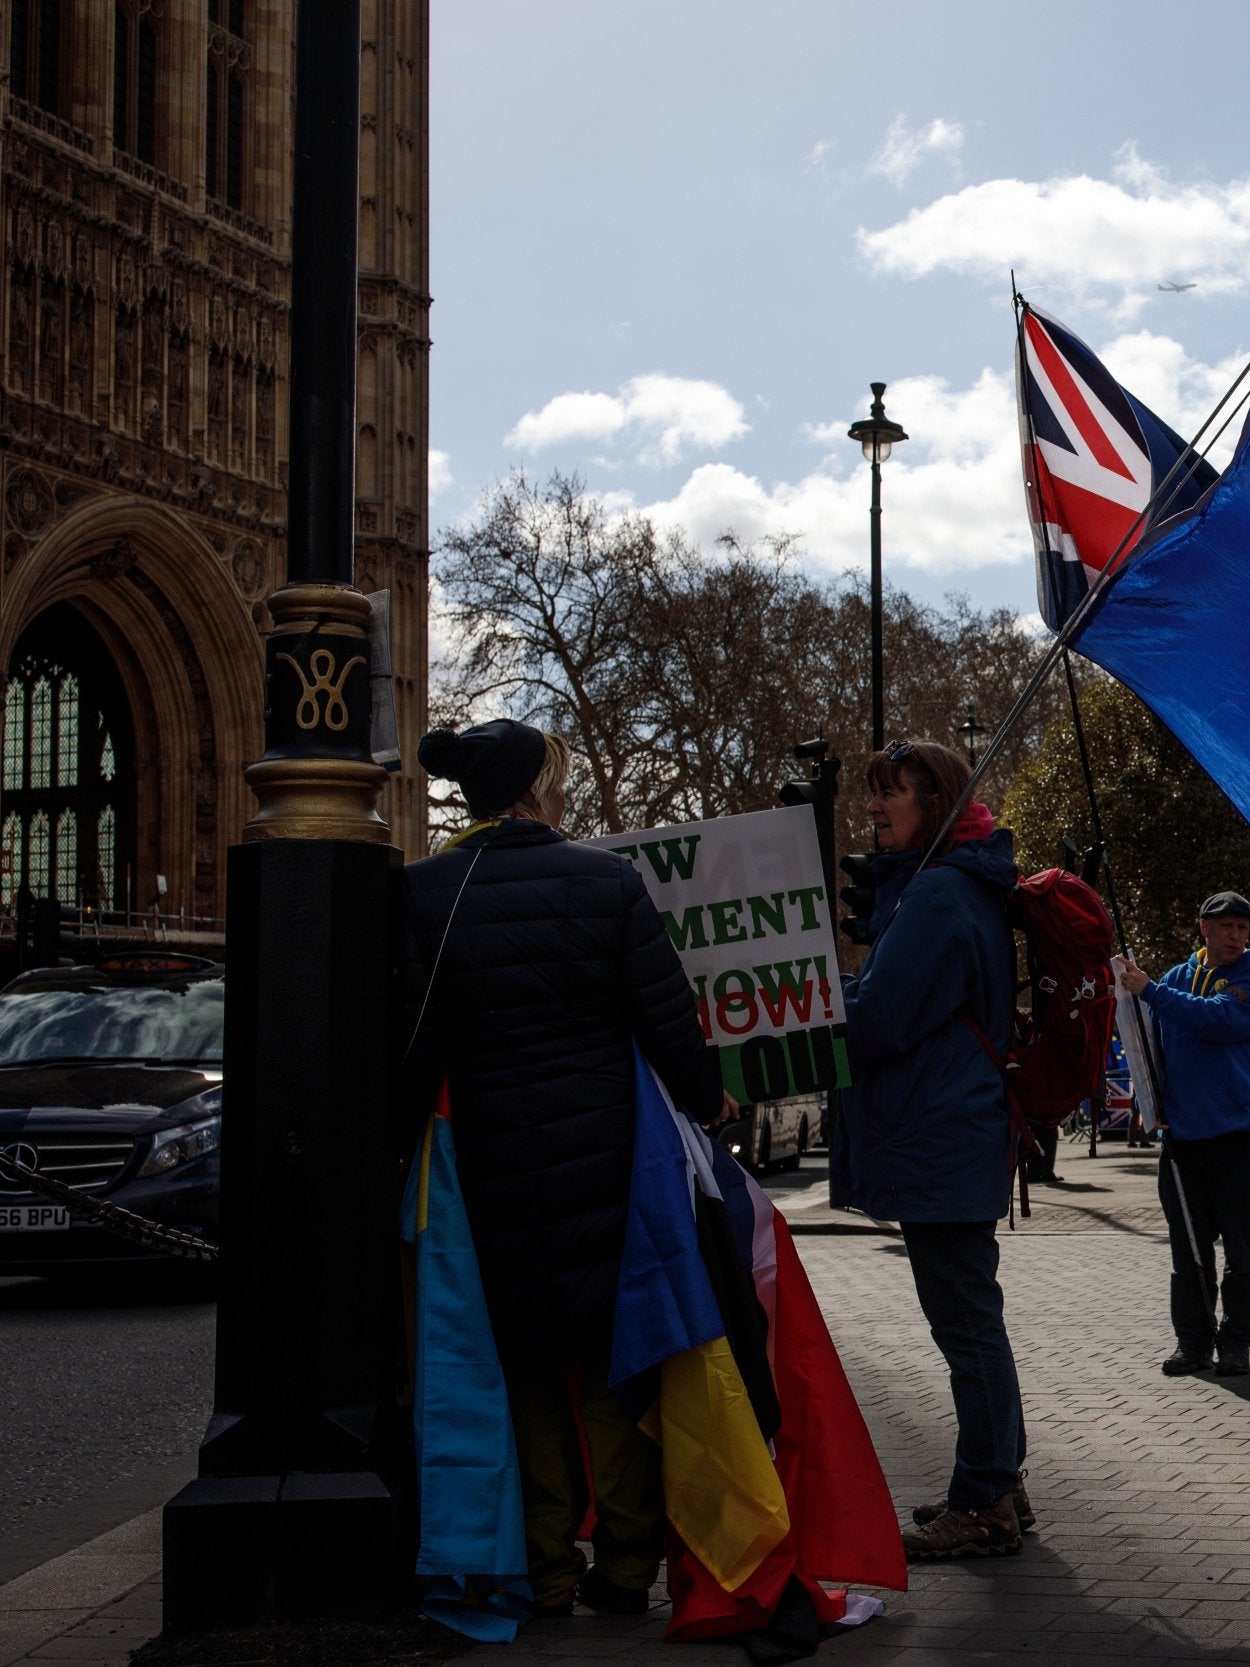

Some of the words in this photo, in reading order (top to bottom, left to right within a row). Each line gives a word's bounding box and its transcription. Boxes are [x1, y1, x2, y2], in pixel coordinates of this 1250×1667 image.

[659, 887, 824, 951] MENT
[740, 1023, 849, 1102] OU
[28, 1208, 65, 1225] BPU
